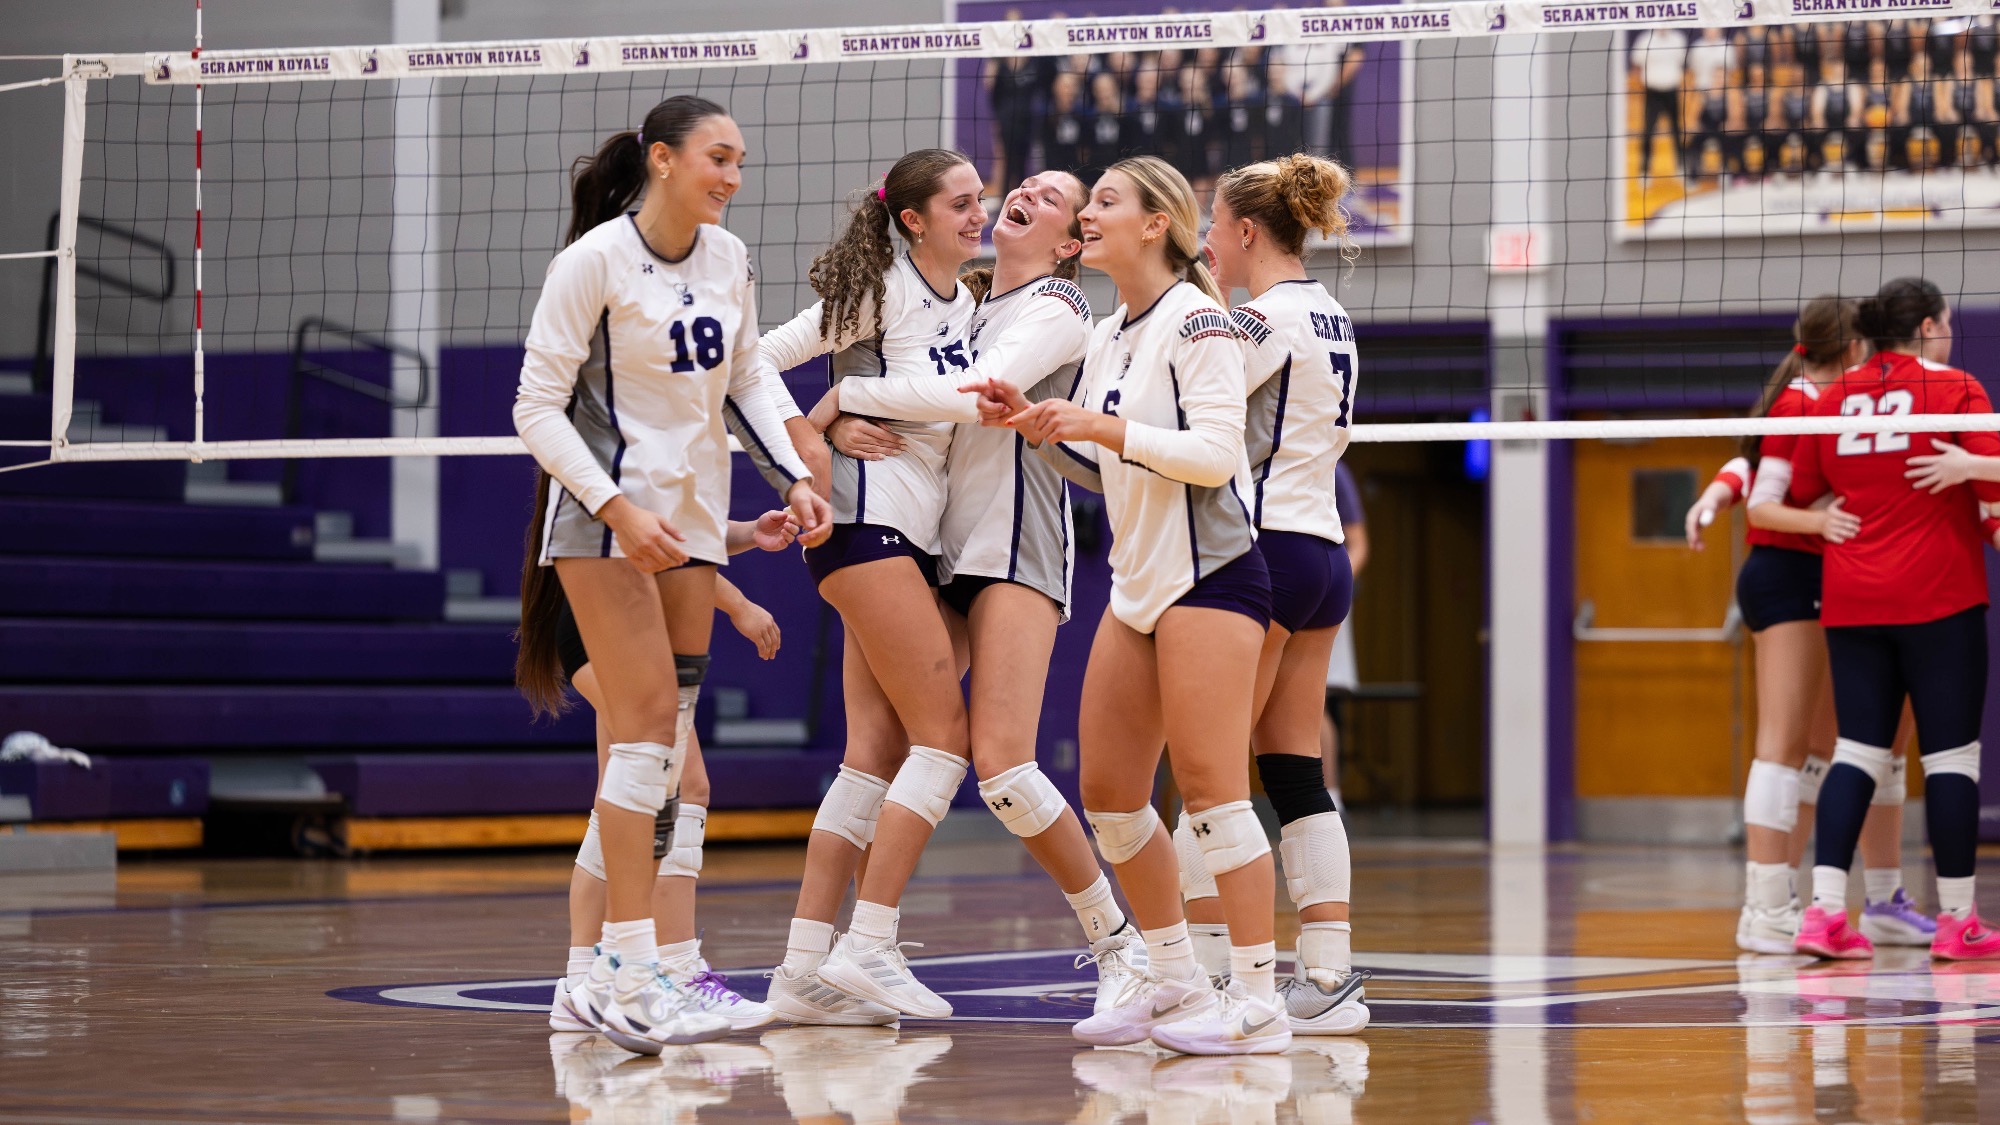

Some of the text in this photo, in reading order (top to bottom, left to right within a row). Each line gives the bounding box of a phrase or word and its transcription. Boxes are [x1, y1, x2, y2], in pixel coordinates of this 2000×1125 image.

[1543, 3, 1697, 23] SCRANTON ROYALS
[1068, 24, 1211, 42] SCRANTON ROYALS
[1302, 14, 1449, 33] SCRANTON ROYALS
[623, 44, 756, 60] SCRANTON ROYALS
[843, 34, 980, 51] SCRANTON ROYALS
[202, 57, 329, 74] SCRANTON ROYALS
[409, 50, 541, 66] SCRANTON ROYALS
[669, 316, 725, 373] 18
[929, 339, 970, 375] 15
[1328, 352, 1352, 428] 7
[1836, 389, 1914, 456] 22
